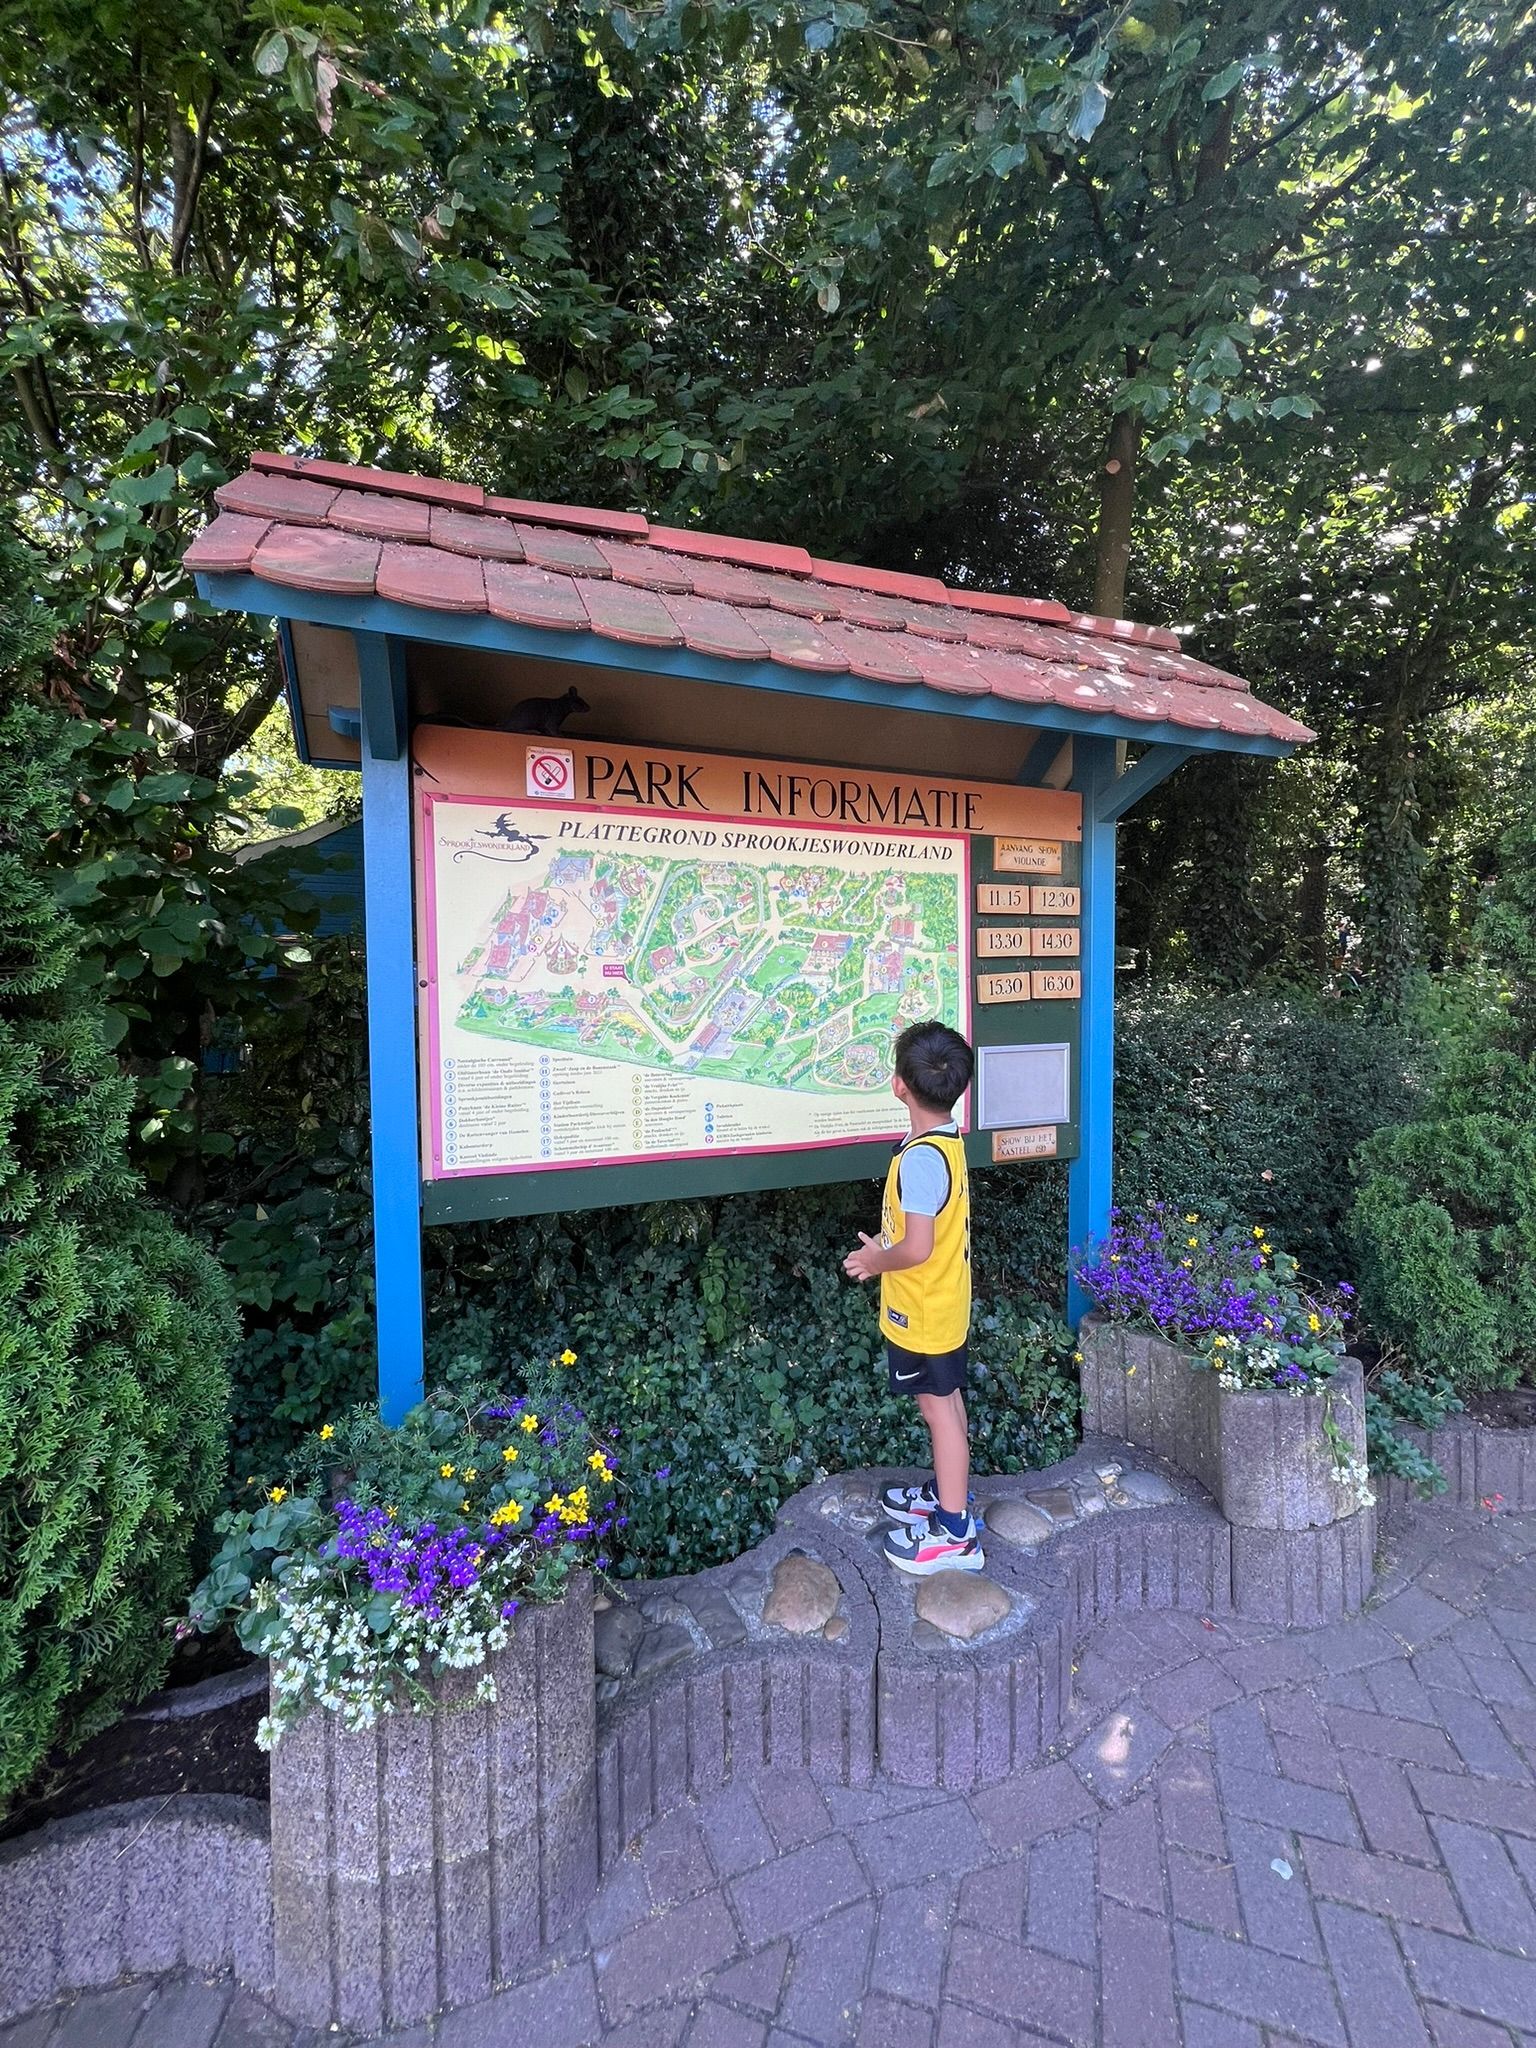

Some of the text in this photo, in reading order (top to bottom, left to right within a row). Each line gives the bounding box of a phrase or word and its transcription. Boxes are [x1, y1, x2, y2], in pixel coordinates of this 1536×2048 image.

[585, 756, 984, 831] PARK INFORMATIE
[558, 821, 953, 860] PLATTEGROND SPROOKJESWONDERLAND
[1001, 844, 1058, 854] AANVANG SHOW
[1014, 857, 1046, 866] VIOLINDE
[989, 890, 1021, 906] 11.15
[1042, 891, 1075, 908] 12.30
[989, 932, 1023, 949] 13.30
[1042, 932, 1073, 949] 14.30
[989, 977, 1023, 996] 15.30
[1043, 975, 1074, 992] 16.30
[1001, 1136, 1021, 1145] SHOW
[1038, 1133, 1052, 1142] HET
[1001, 1146, 1031, 1156] KASTEEL
